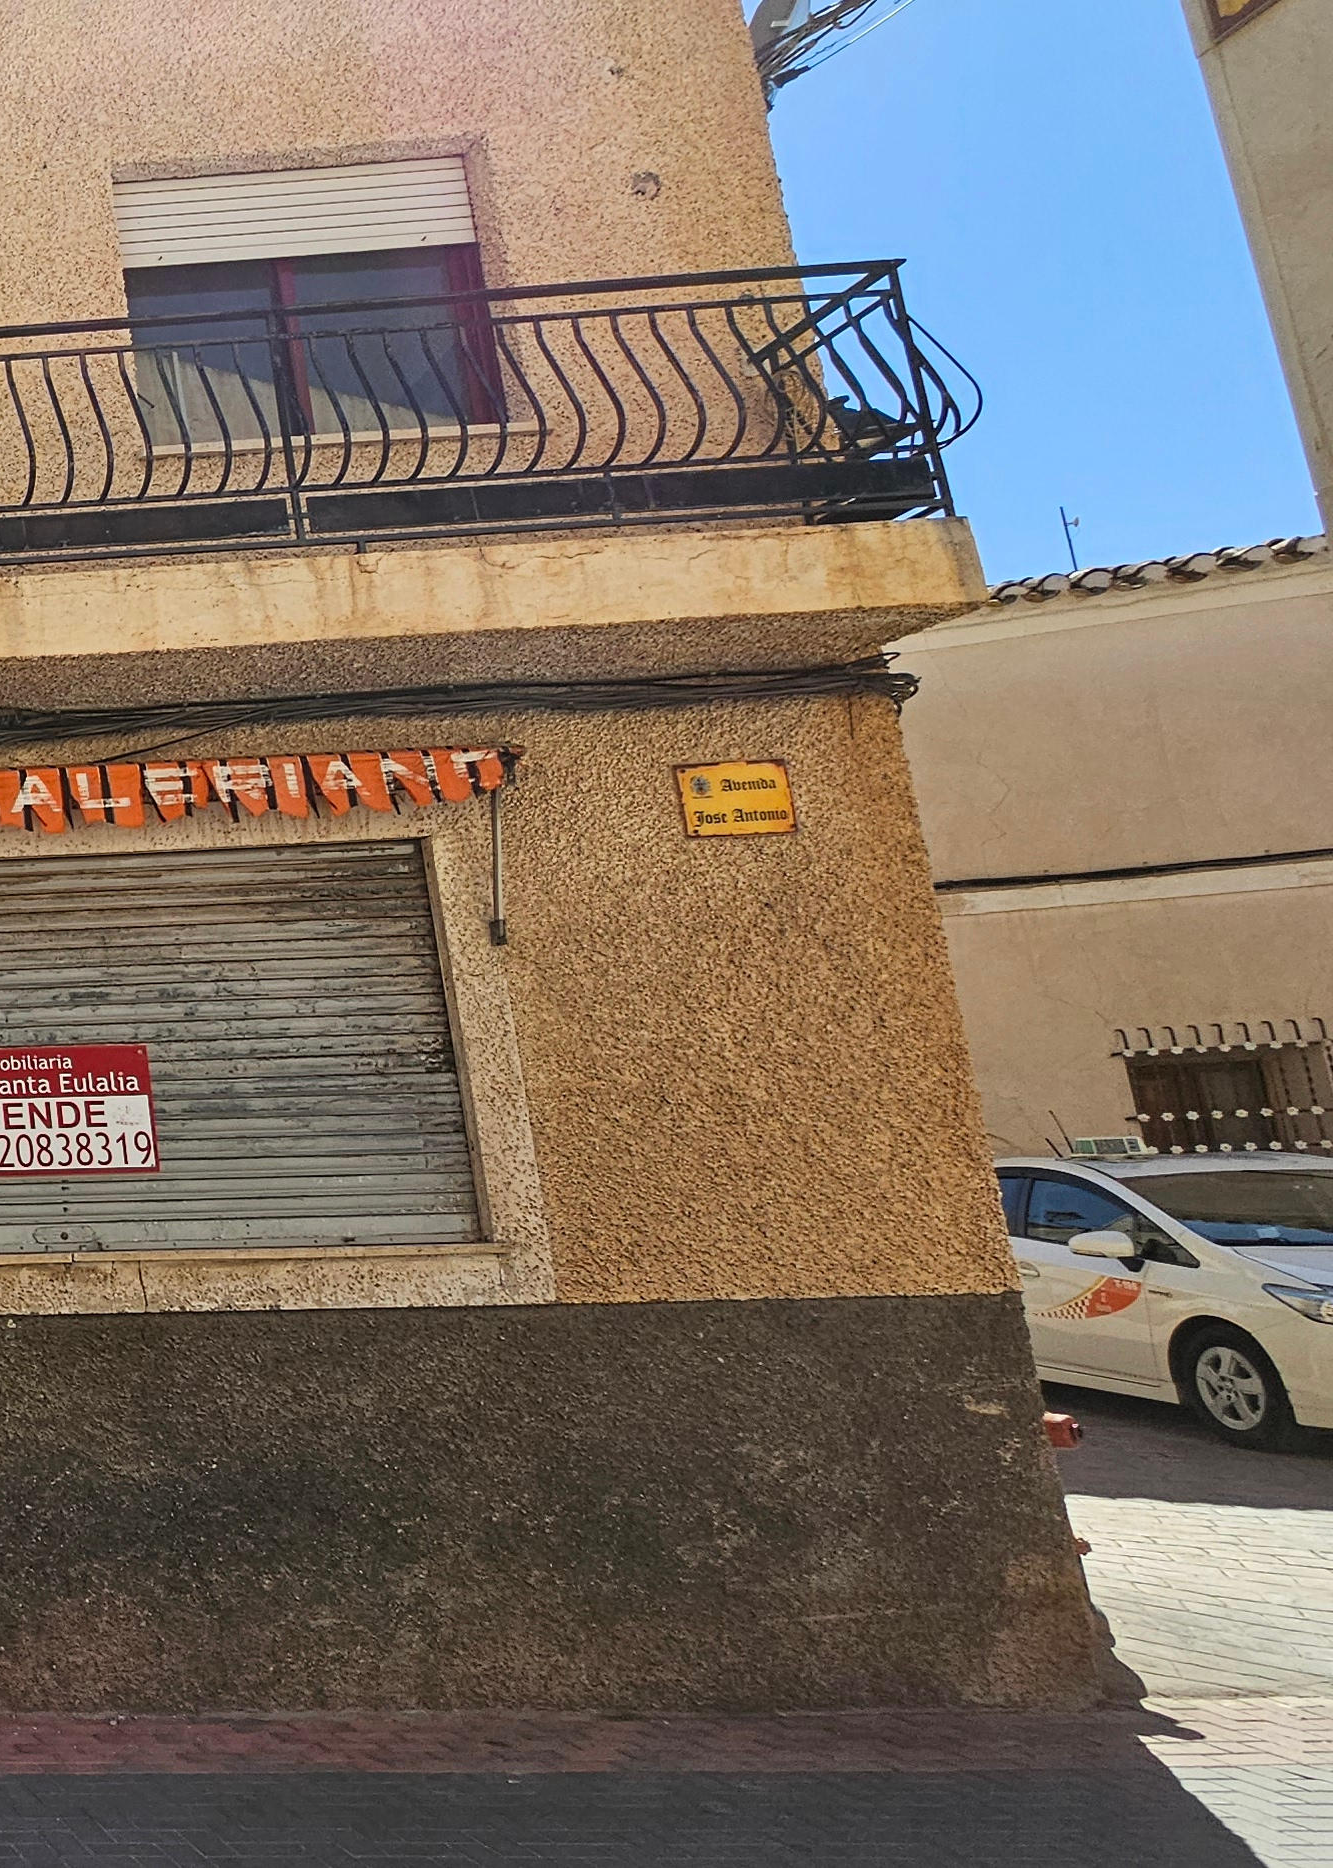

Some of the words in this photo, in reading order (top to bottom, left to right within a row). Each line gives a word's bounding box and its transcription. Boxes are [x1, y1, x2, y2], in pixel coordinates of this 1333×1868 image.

[720, 777, 777, 792] Avenida
[693, 810, 728, 828] Jose
[732, 808, 789, 823] Antonio
[59, 1071, 140, 1093] Eulalia
